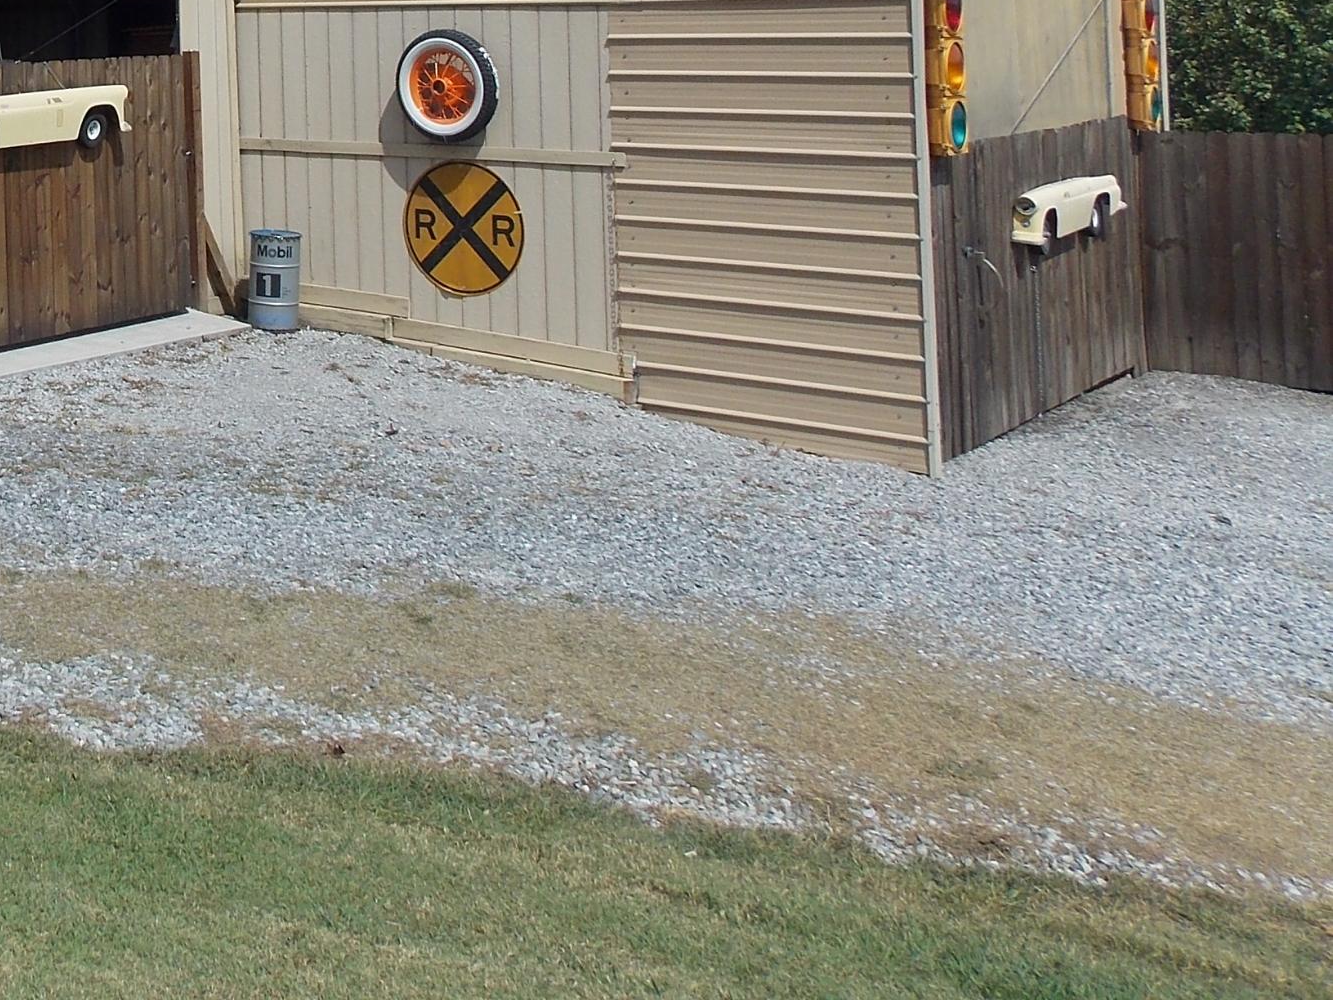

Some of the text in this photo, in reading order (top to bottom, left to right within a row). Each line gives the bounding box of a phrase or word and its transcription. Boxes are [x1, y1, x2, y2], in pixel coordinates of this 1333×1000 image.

[414, 208, 437, 241] R
[491, 214, 515, 248] R
[256, 243, 293, 259] Mobil
[262, 274, 272, 297] 1
